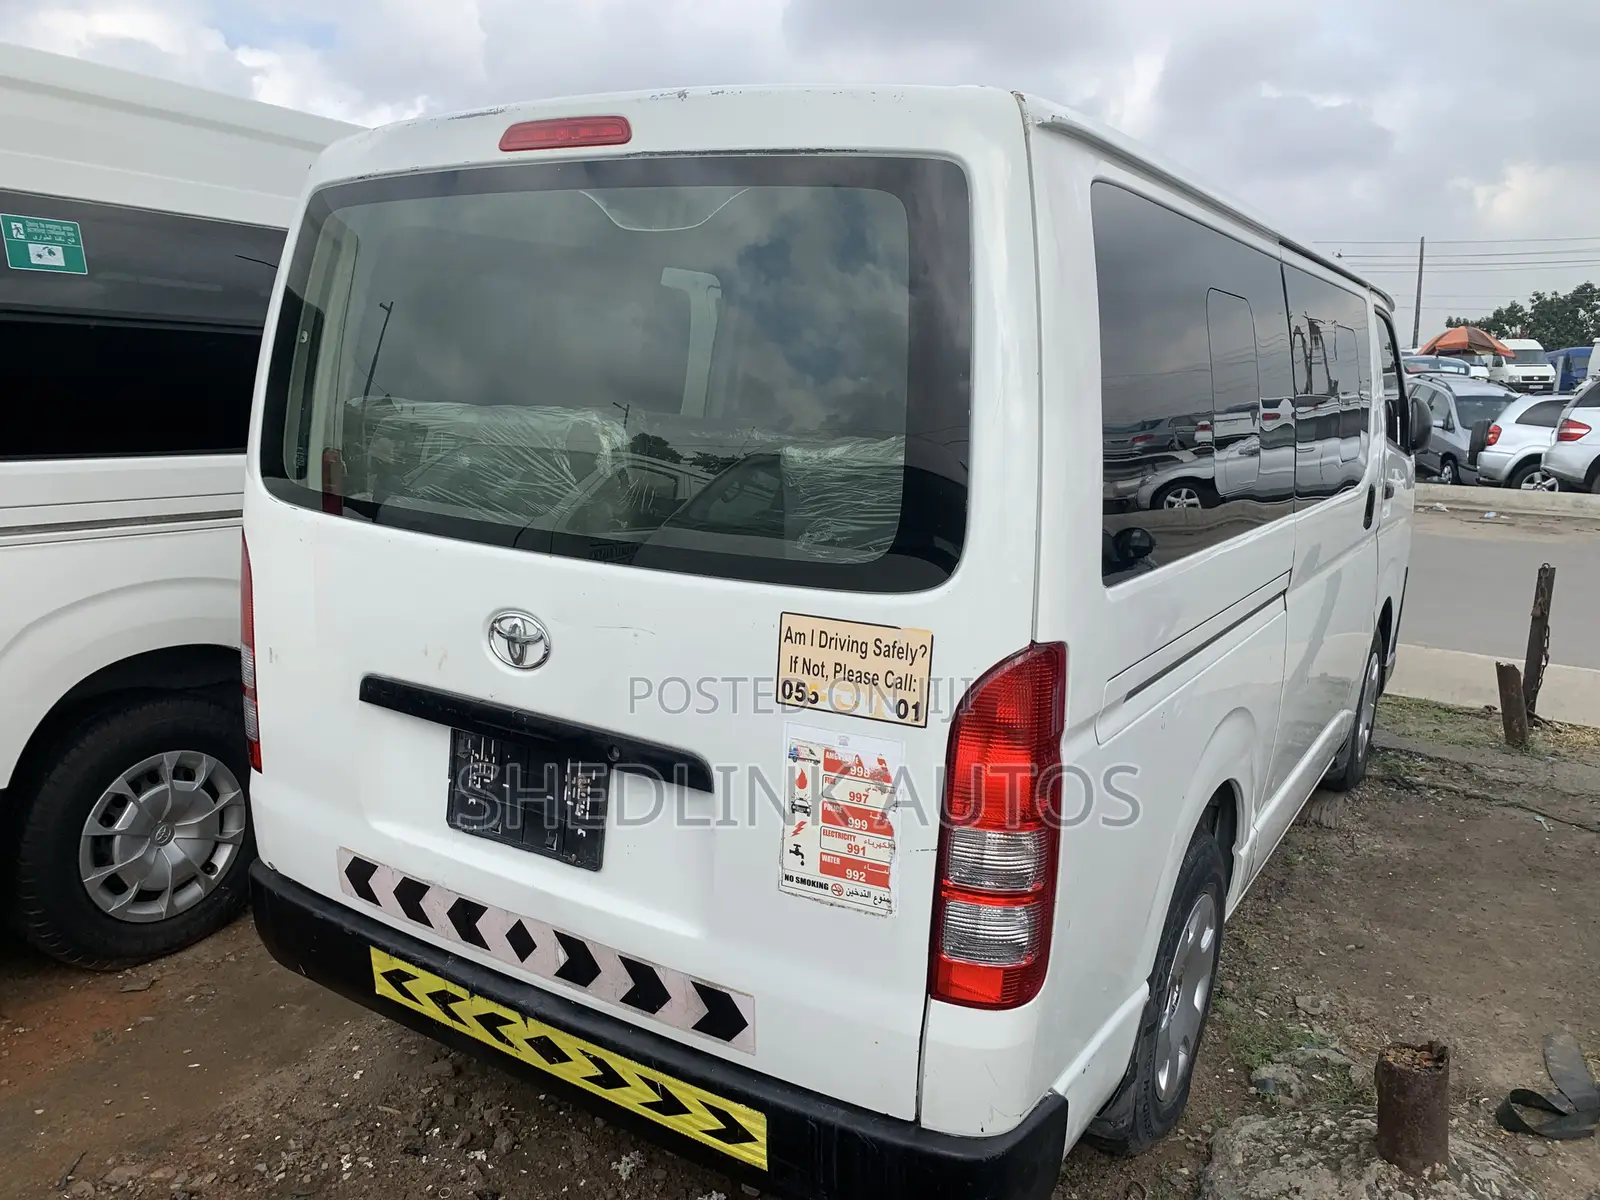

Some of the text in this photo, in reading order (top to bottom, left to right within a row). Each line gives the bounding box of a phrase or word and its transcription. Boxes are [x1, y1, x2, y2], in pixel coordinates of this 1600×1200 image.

[784, 626, 928, 666] Am I Driving Safely?
[789, 655, 917, 692] If Not, Please Call:
[849, 791, 869, 804] 997
[823, 802, 843, 813] POLICE
[847, 816, 868, 831] 999
[822, 829, 857, 842] ELECTRICITY
[847, 843, 867, 857] 991
[821, 853, 841, 865] WATER
[784, 873, 829, 891] NO SMOKING
[845, 868, 867, 883] 992
